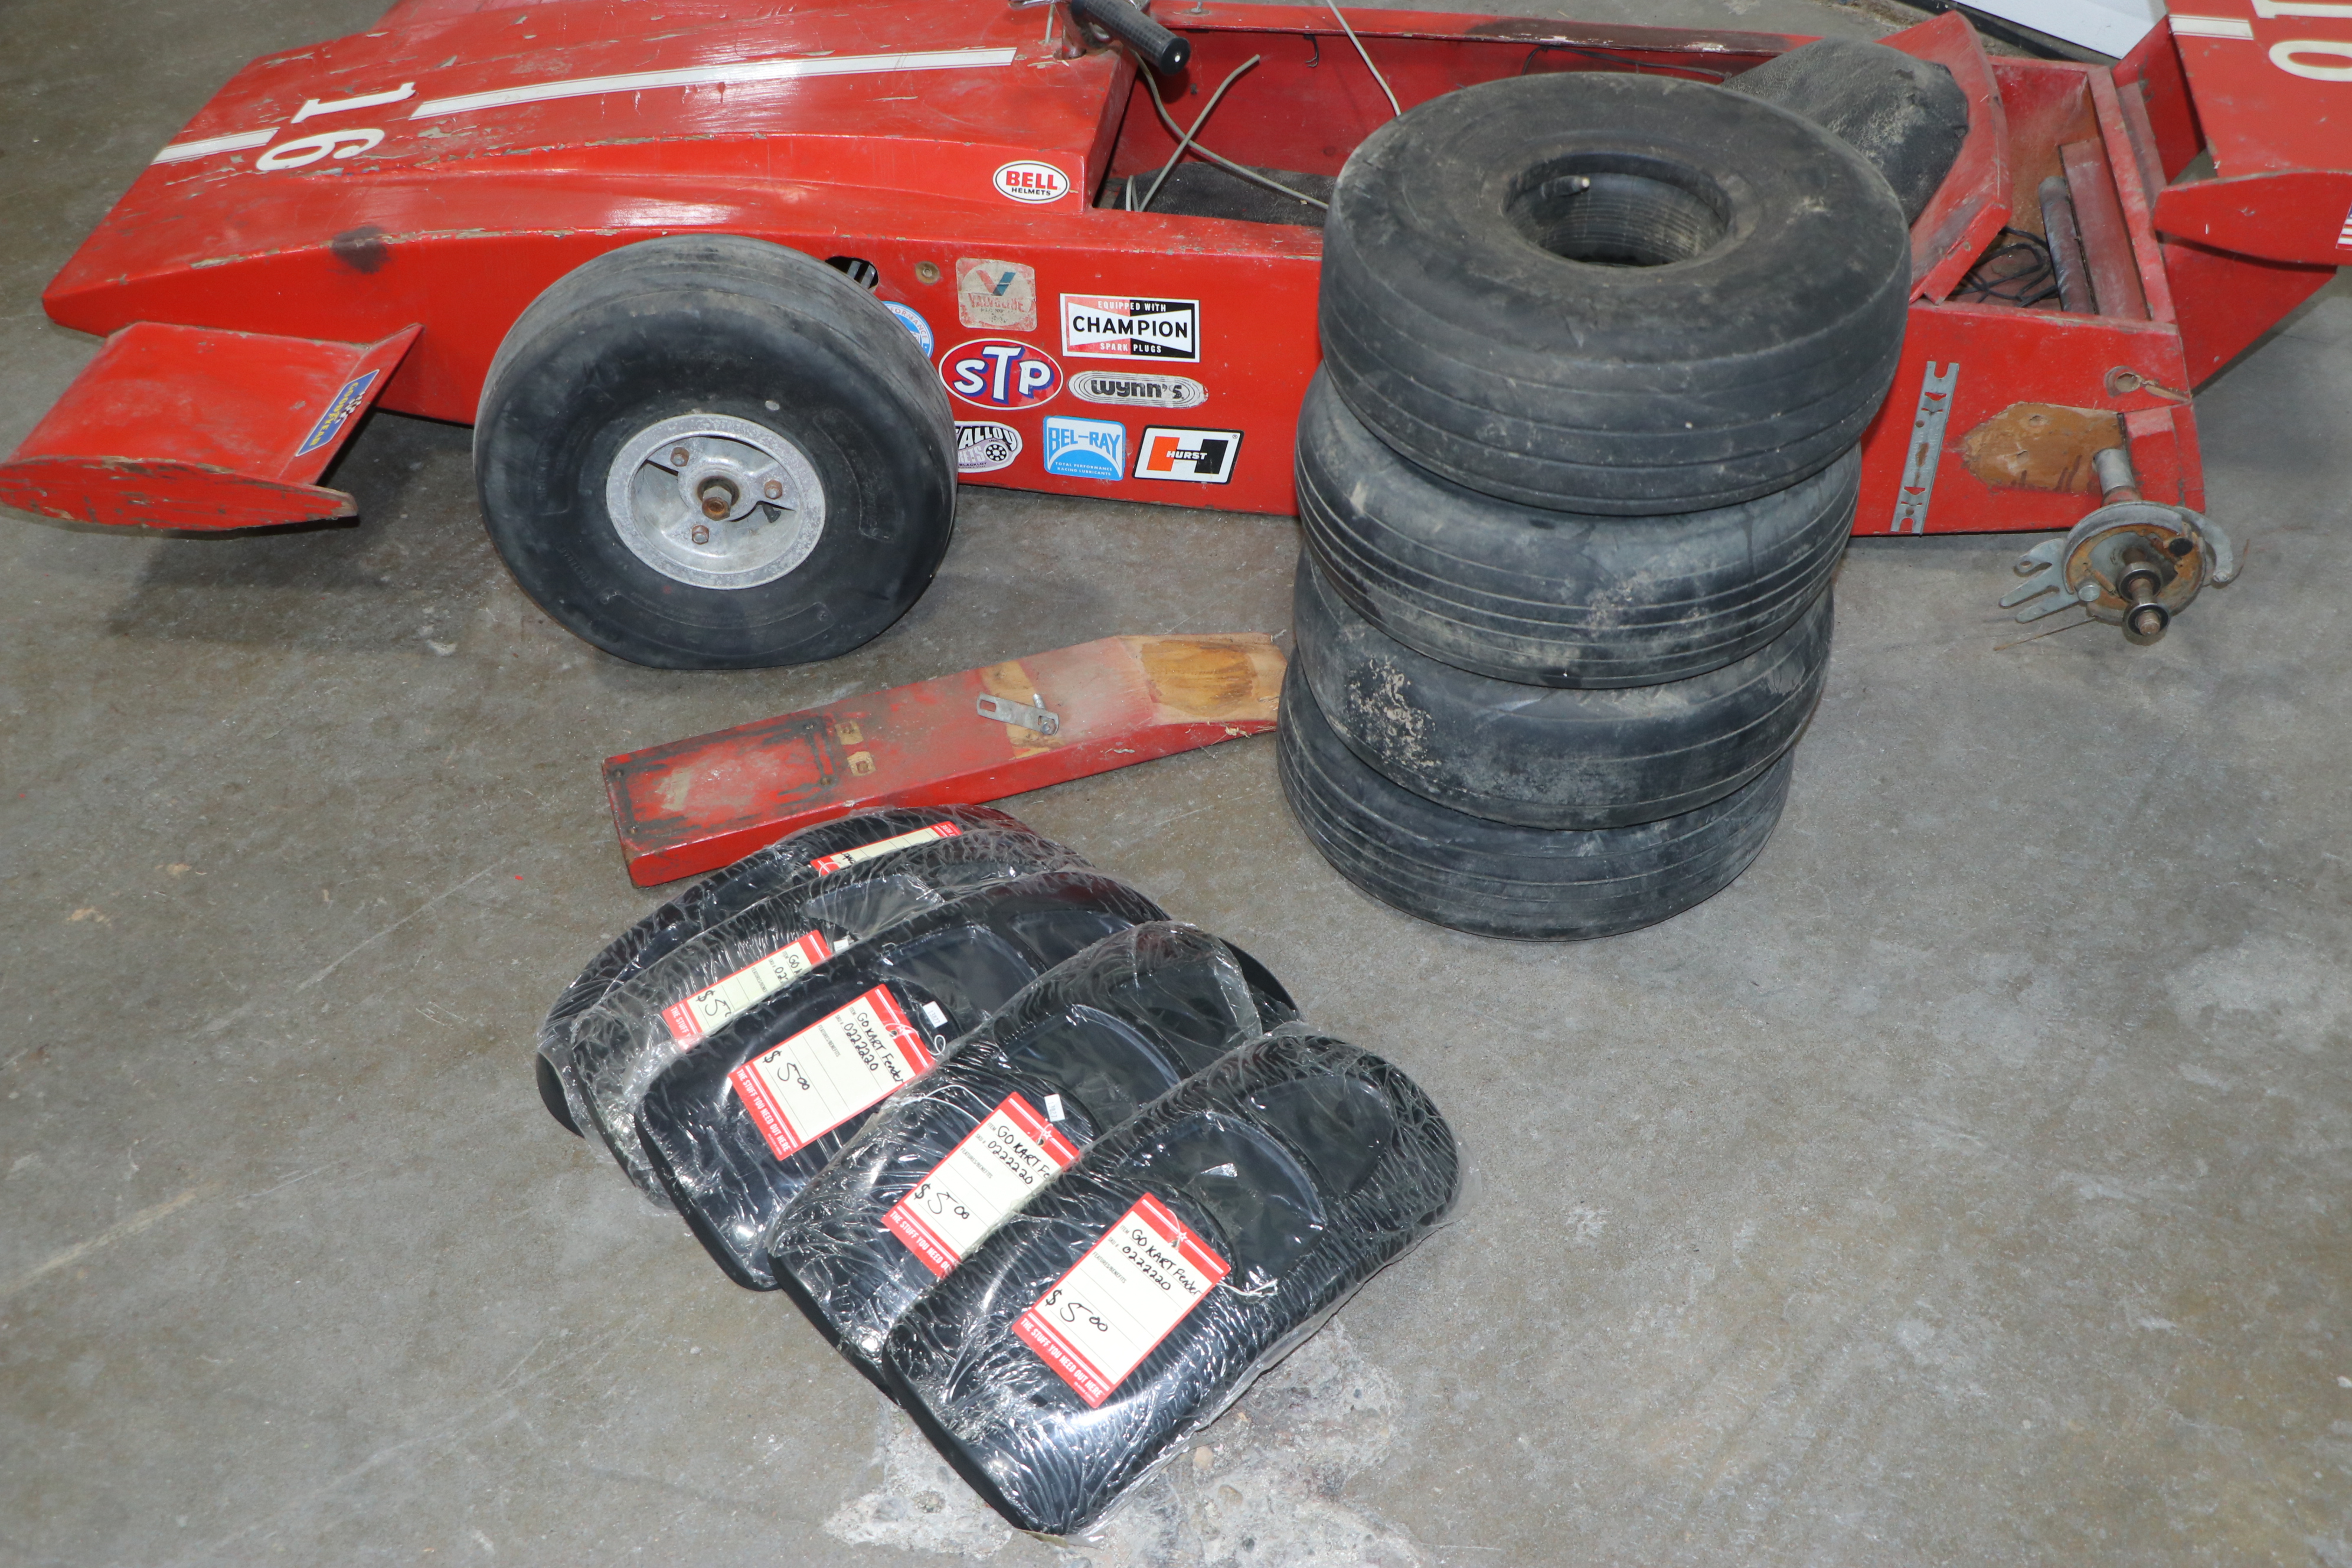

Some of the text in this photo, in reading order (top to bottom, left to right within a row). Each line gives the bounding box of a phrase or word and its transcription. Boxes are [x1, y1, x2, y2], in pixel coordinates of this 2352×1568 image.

[1005, 170, 1058, 190] BELL
[1011, 187, 1051, 196] HELMETS
[1097, 300, 1167, 312] EQUIPPED WITH
[890, 307, 928, 339] FORMANCE
[1073, 315, 1188, 338] CHAMPION
[1100, 342, 1162, 353] SPARK PLUGS
[953, 345, 1053, 403] STP
[309, 382, 359, 446] GOODYEAR
[955, 426, 1017, 452] ALLOY
[1048, 427, 1121, 465] BEL-RAY
[1166, 450, 1208, 460] HURST
[788, 954, 801, 969] GO
[671, 1006, 681, 1018] THE
[675, 1017, 690, 1033] STUFF
[818, 1024, 841, 1057] FEATURES/BENEFITS
[844, 1023, 879, 1072] 0222220
[857, 1012, 870, 1027] GO
[864, 1028, 887, 1051] KART
[736, 1069, 748, 1082] THE
[743, 1079, 758, 1096] STUFF
[753, 1096, 765, 1109] YOU
[760, 1108, 774, 1125] NEED
[769, 1123, 782, 1136] OUT
[776, 1135, 791, 1152] HERE
[988, 1123, 1041, 1167] ITEM GO KART
[960, 1147, 993, 1179] FEATURES/BENEFITS
[987, 1141, 1033, 1185] 0222220
[890, 1210, 903, 1224] THE
[900, 1220, 919, 1239] STUFF
[916, 1236, 930, 1250] YOU
[926, 1247, 943, 1264] NEED
[1120, 1225, 1130, 1234] ITEM
[1132, 1229, 1148, 1247] GO
[1145, 1245, 1177, 1270] KART
[1092, 1251, 1127, 1283] FEATURES/BENEFITS
[1108, 1237, 1116, 1245] SKU
[1122, 1246, 1171, 1291] 0222220
[1020, 1318, 1034, 1332] THE
[1031, 1328, 1051, 1347] STUFF
[1048, 1344, 1063, 1358] YOU
[1059, 1355, 1077, 1373] NEED
[1073, 1369, 1089, 1383] OUT
[1084, 1380, 1103, 1398] HERE
